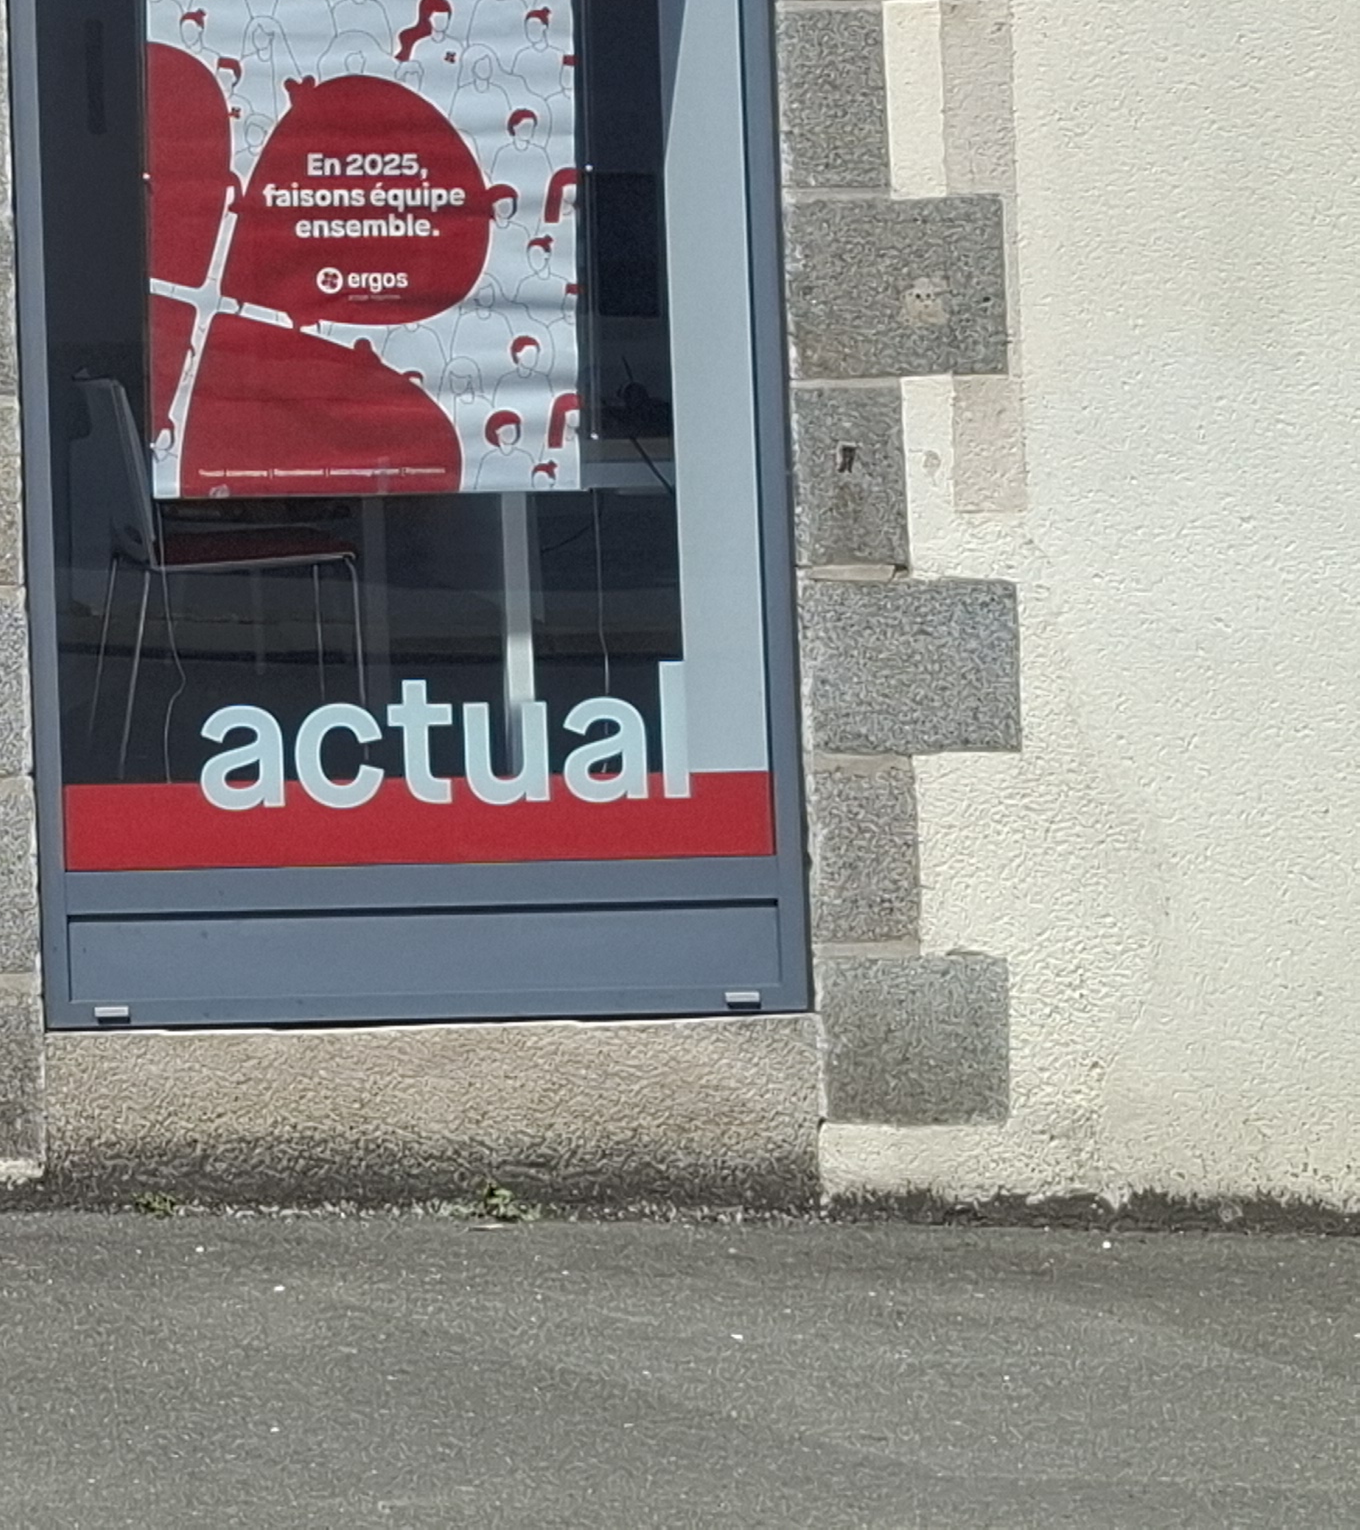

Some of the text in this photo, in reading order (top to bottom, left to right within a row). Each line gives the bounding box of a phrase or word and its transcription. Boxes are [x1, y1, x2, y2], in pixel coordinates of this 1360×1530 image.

[307, 153, 428, 180] En 2025,
[262, 182, 466, 212] faisons équipe
[295, 214, 440, 238] ensemble.
[347, 272, 408, 293] ergos
[199, 660, 692, 810] actual
